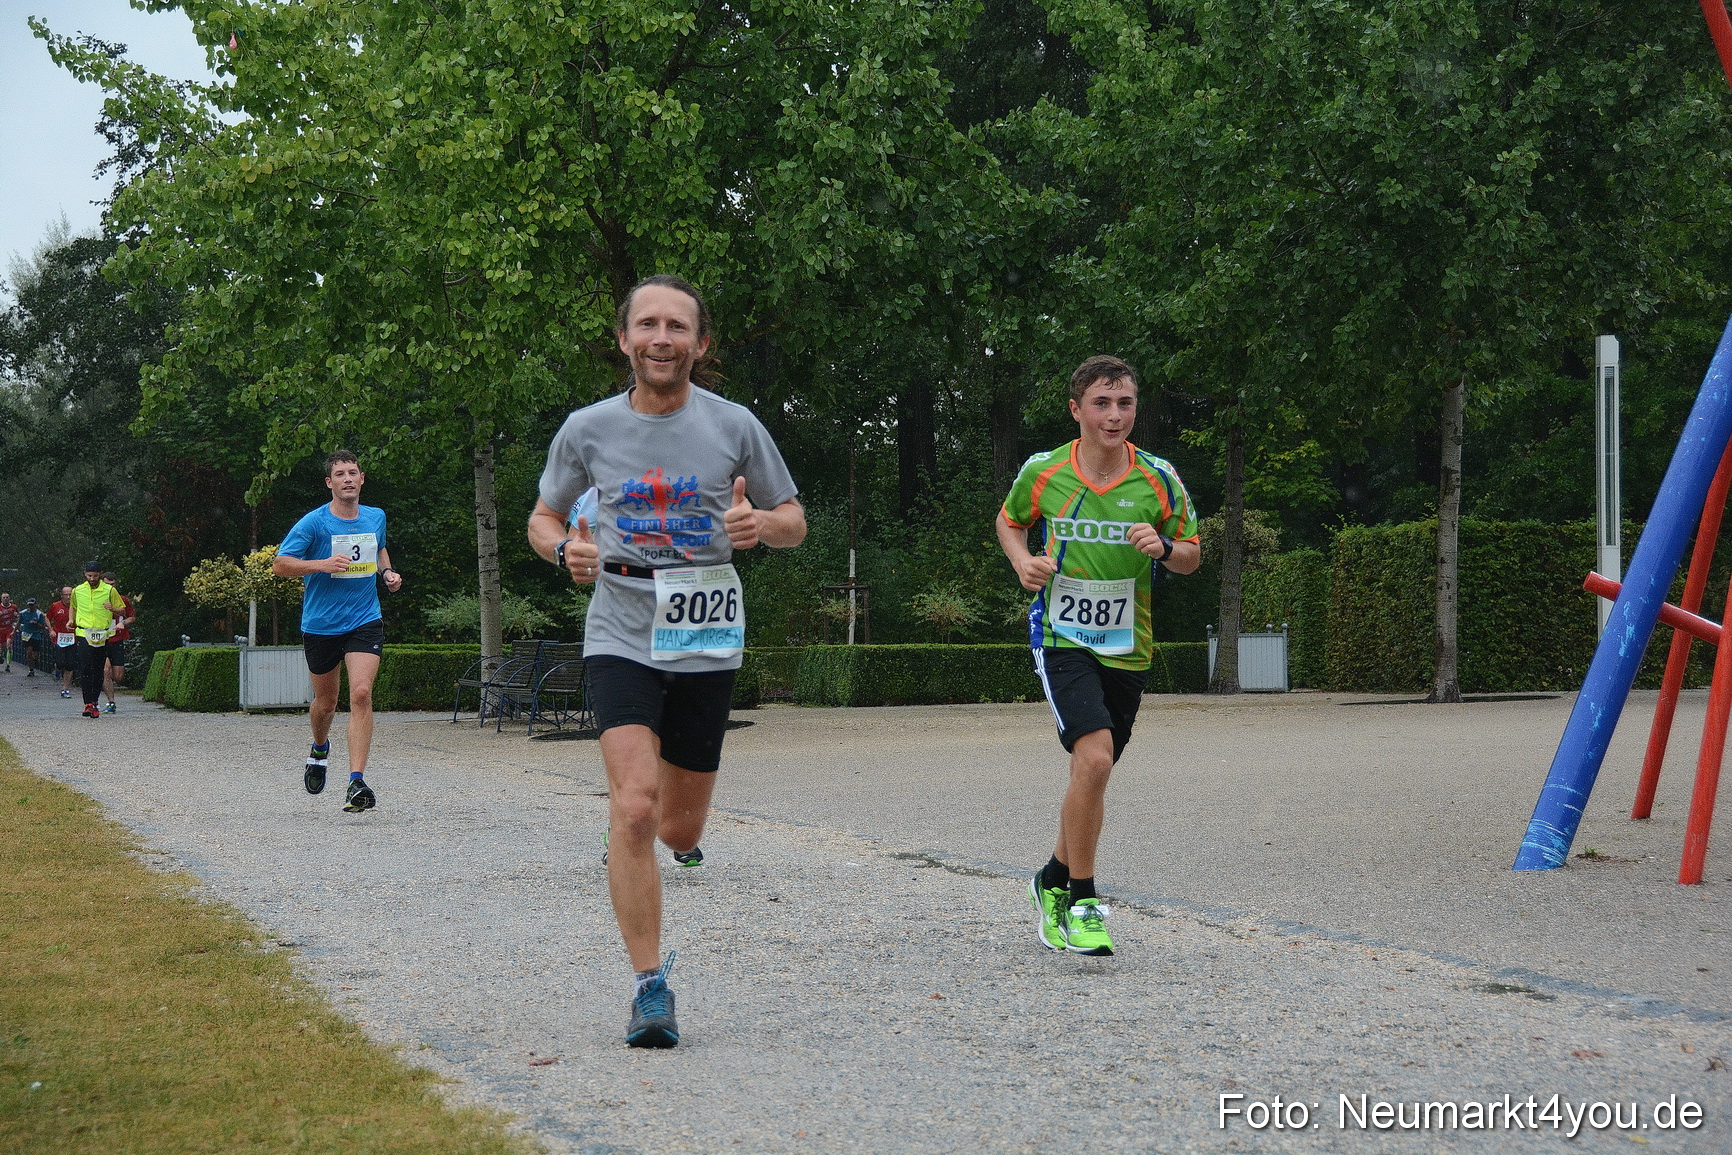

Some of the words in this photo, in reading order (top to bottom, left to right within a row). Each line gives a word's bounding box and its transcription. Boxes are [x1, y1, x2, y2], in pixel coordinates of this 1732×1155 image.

[630, 518, 701, 530] FINISHER
[351, 545, 361, 561] 3
[665, 587, 737, 625] 3026
[1058, 594, 1128, 627] 2887
[91, 632, 101, 641] 80
[1075, 631, 1106, 645] David
